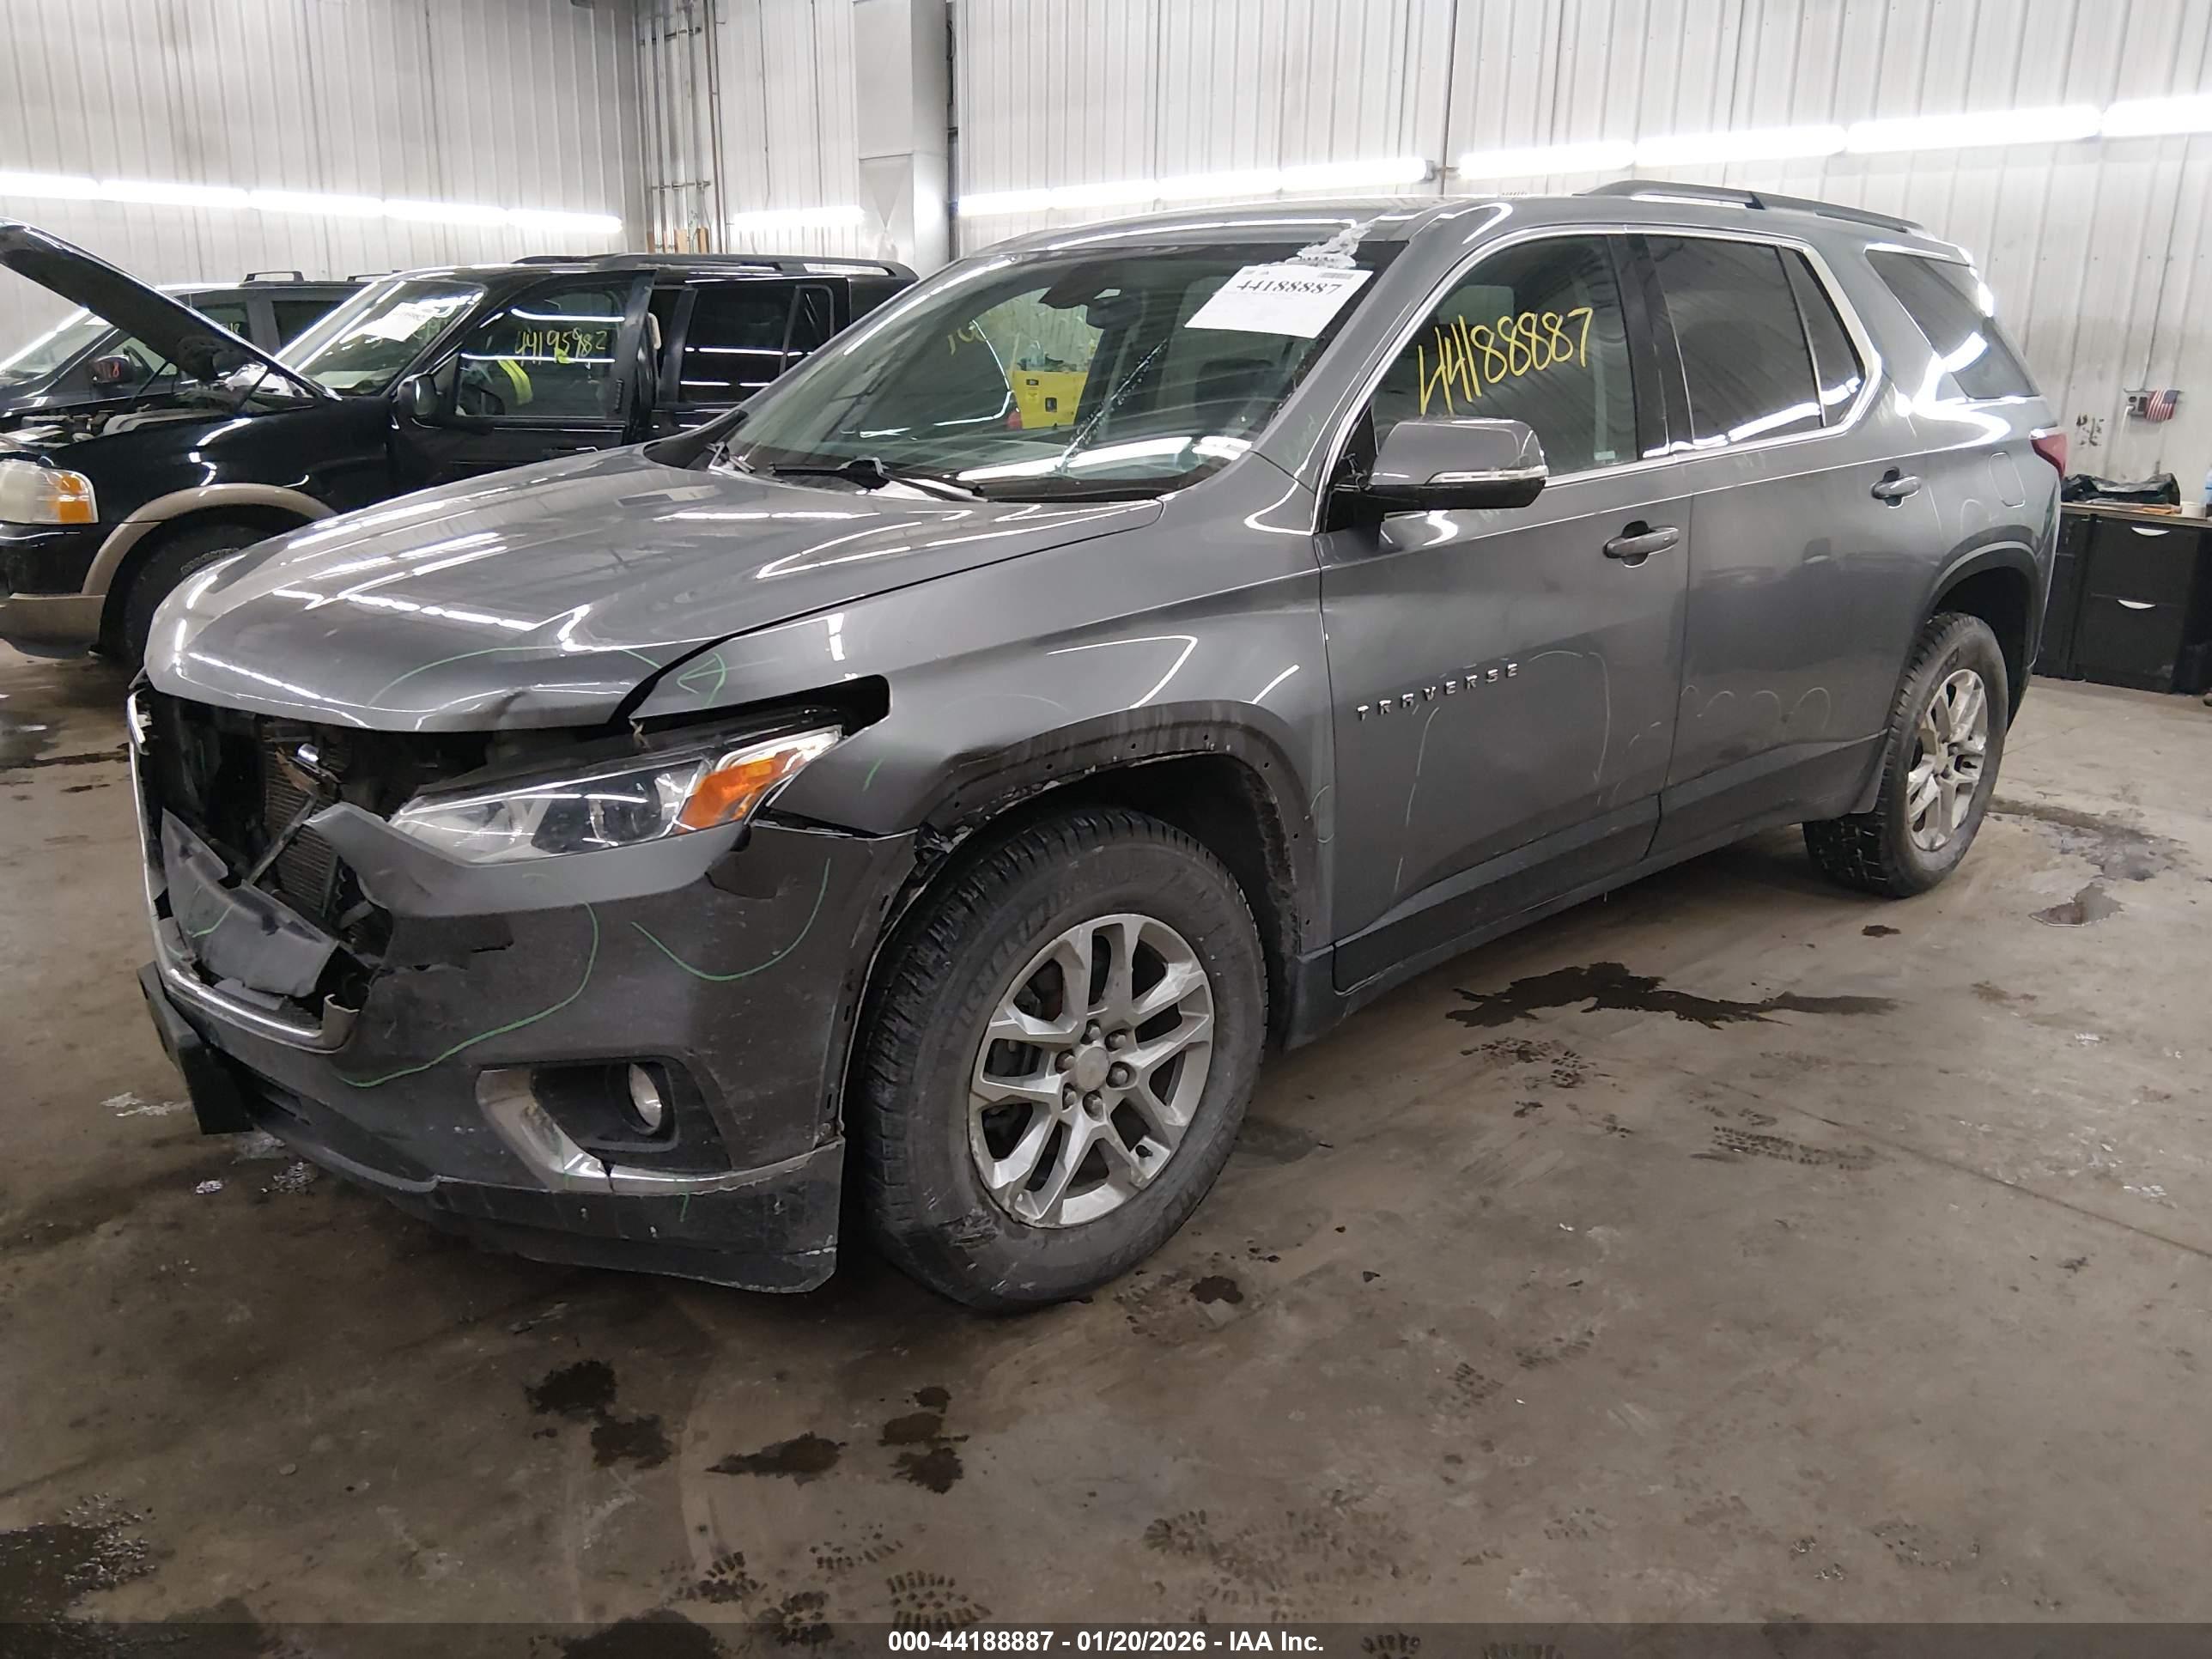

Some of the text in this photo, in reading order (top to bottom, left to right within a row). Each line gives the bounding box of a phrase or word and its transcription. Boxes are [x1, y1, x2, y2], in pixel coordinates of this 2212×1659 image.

[1236, 280, 1343, 295] 44188887
[1418, 307, 1594, 416] 44188887
[1357, 663, 1518, 721] TRAVERSE
